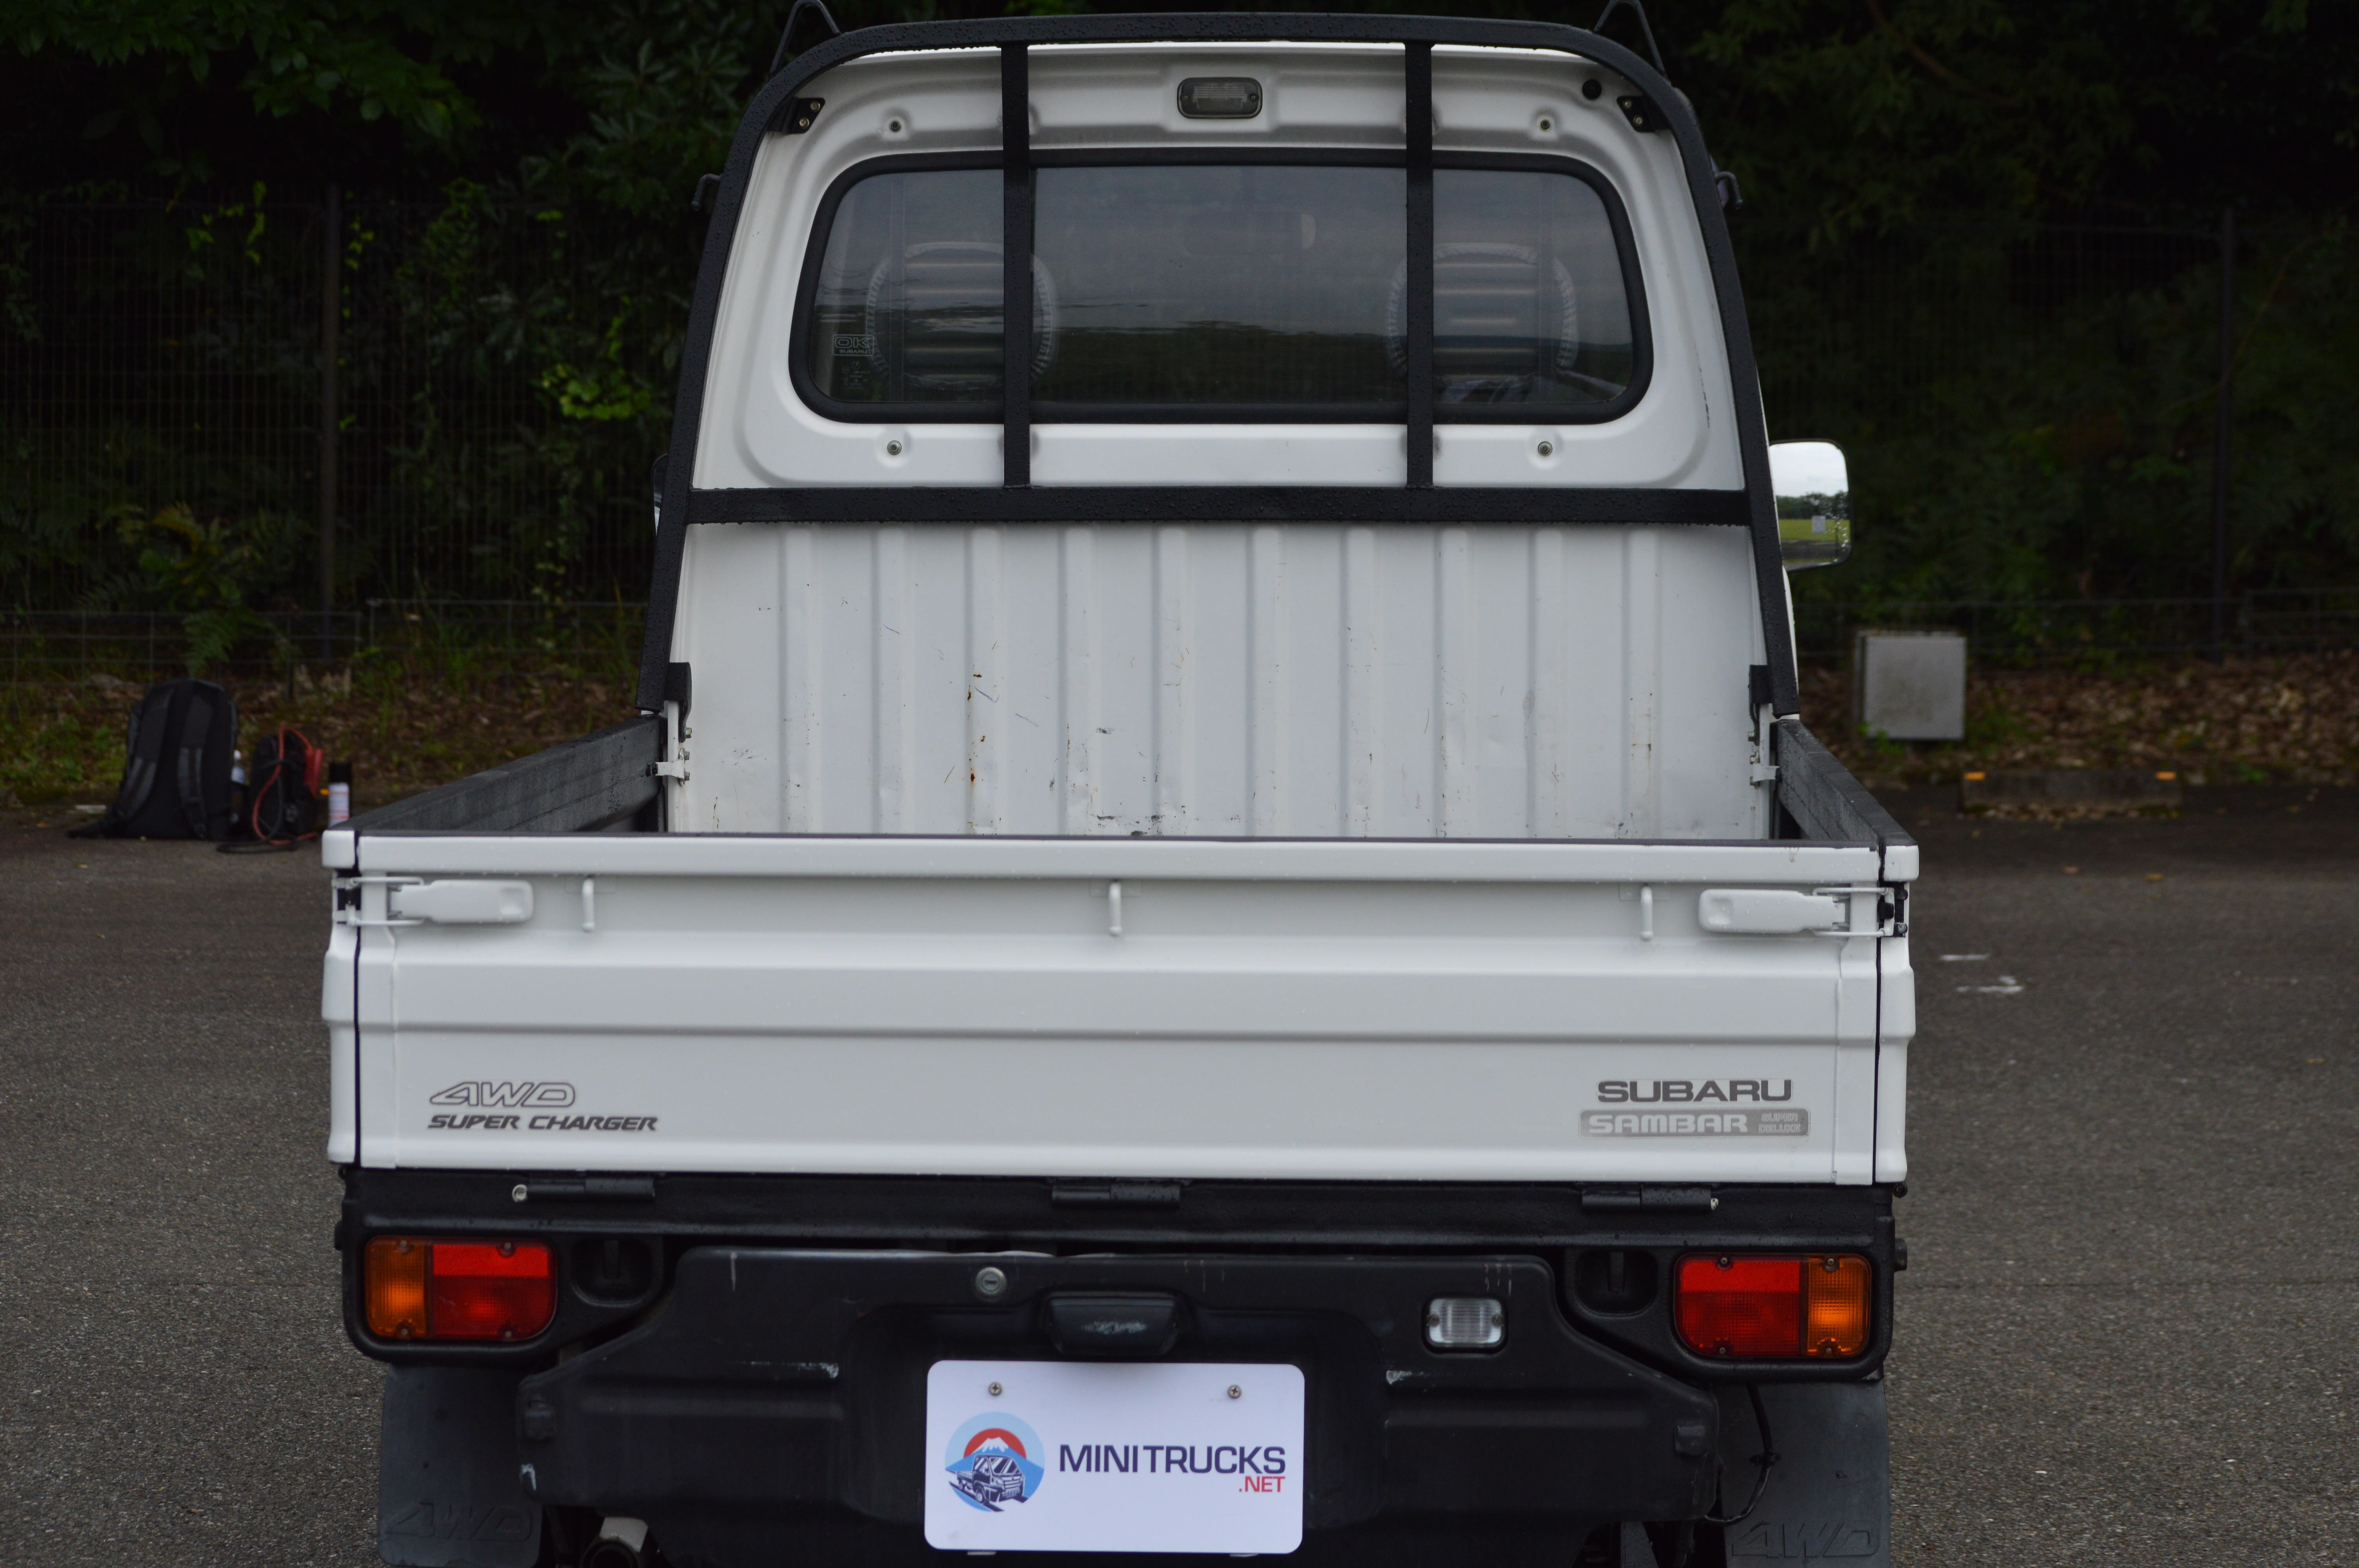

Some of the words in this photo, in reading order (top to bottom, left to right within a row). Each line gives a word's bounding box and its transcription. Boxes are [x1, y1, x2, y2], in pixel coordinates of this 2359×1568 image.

[834, 337, 871, 348] OK
[430, 1082, 575, 1107] 4WD
[1598, 1080, 1792, 1102] SUBARU
[428, 1115, 520, 1129] SUPER
[529, 1116, 658, 1131] CHARGER
[1589, 1114, 1748, 1133] SAMBAR
[1761, 1113, 1798, 1121] SUPER
[1759, 1124, 1801, 1132] DELUXE
[1060, 1445, 1285, 1474] MINITRUCKS
[1239, 1476, 1285, 1492] .NET
[384, 1501, 533, 1542] 4WD
[1732, 1521, 1881, 1558] 4WD
